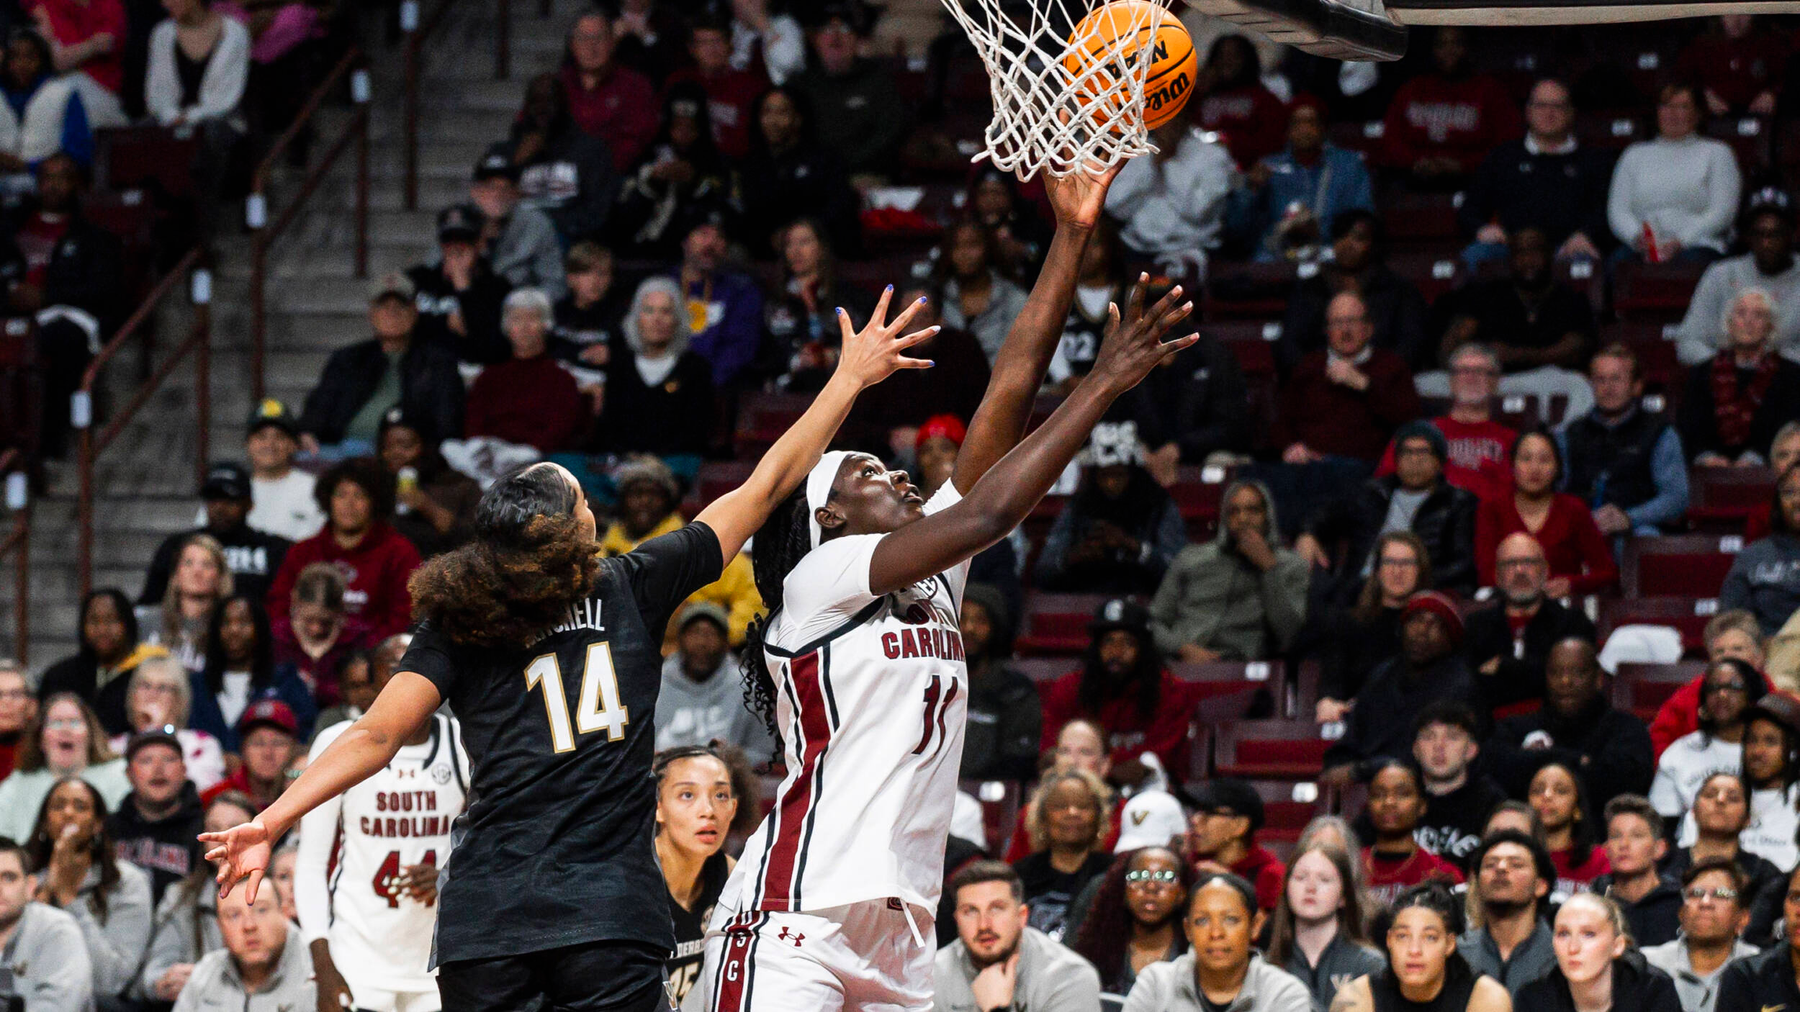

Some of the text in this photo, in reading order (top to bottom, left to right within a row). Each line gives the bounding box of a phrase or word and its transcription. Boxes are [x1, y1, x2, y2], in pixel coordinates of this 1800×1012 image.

[1104, 40, 1168, 80] NAA
[523, 640, 629, 754] 14
[913, 674, 959, 755] 11
[375, 790, 437, 812] SOUTH
[360, 814, 449, 838] CAROLINA
[1130, 809, 1150, 826] V
